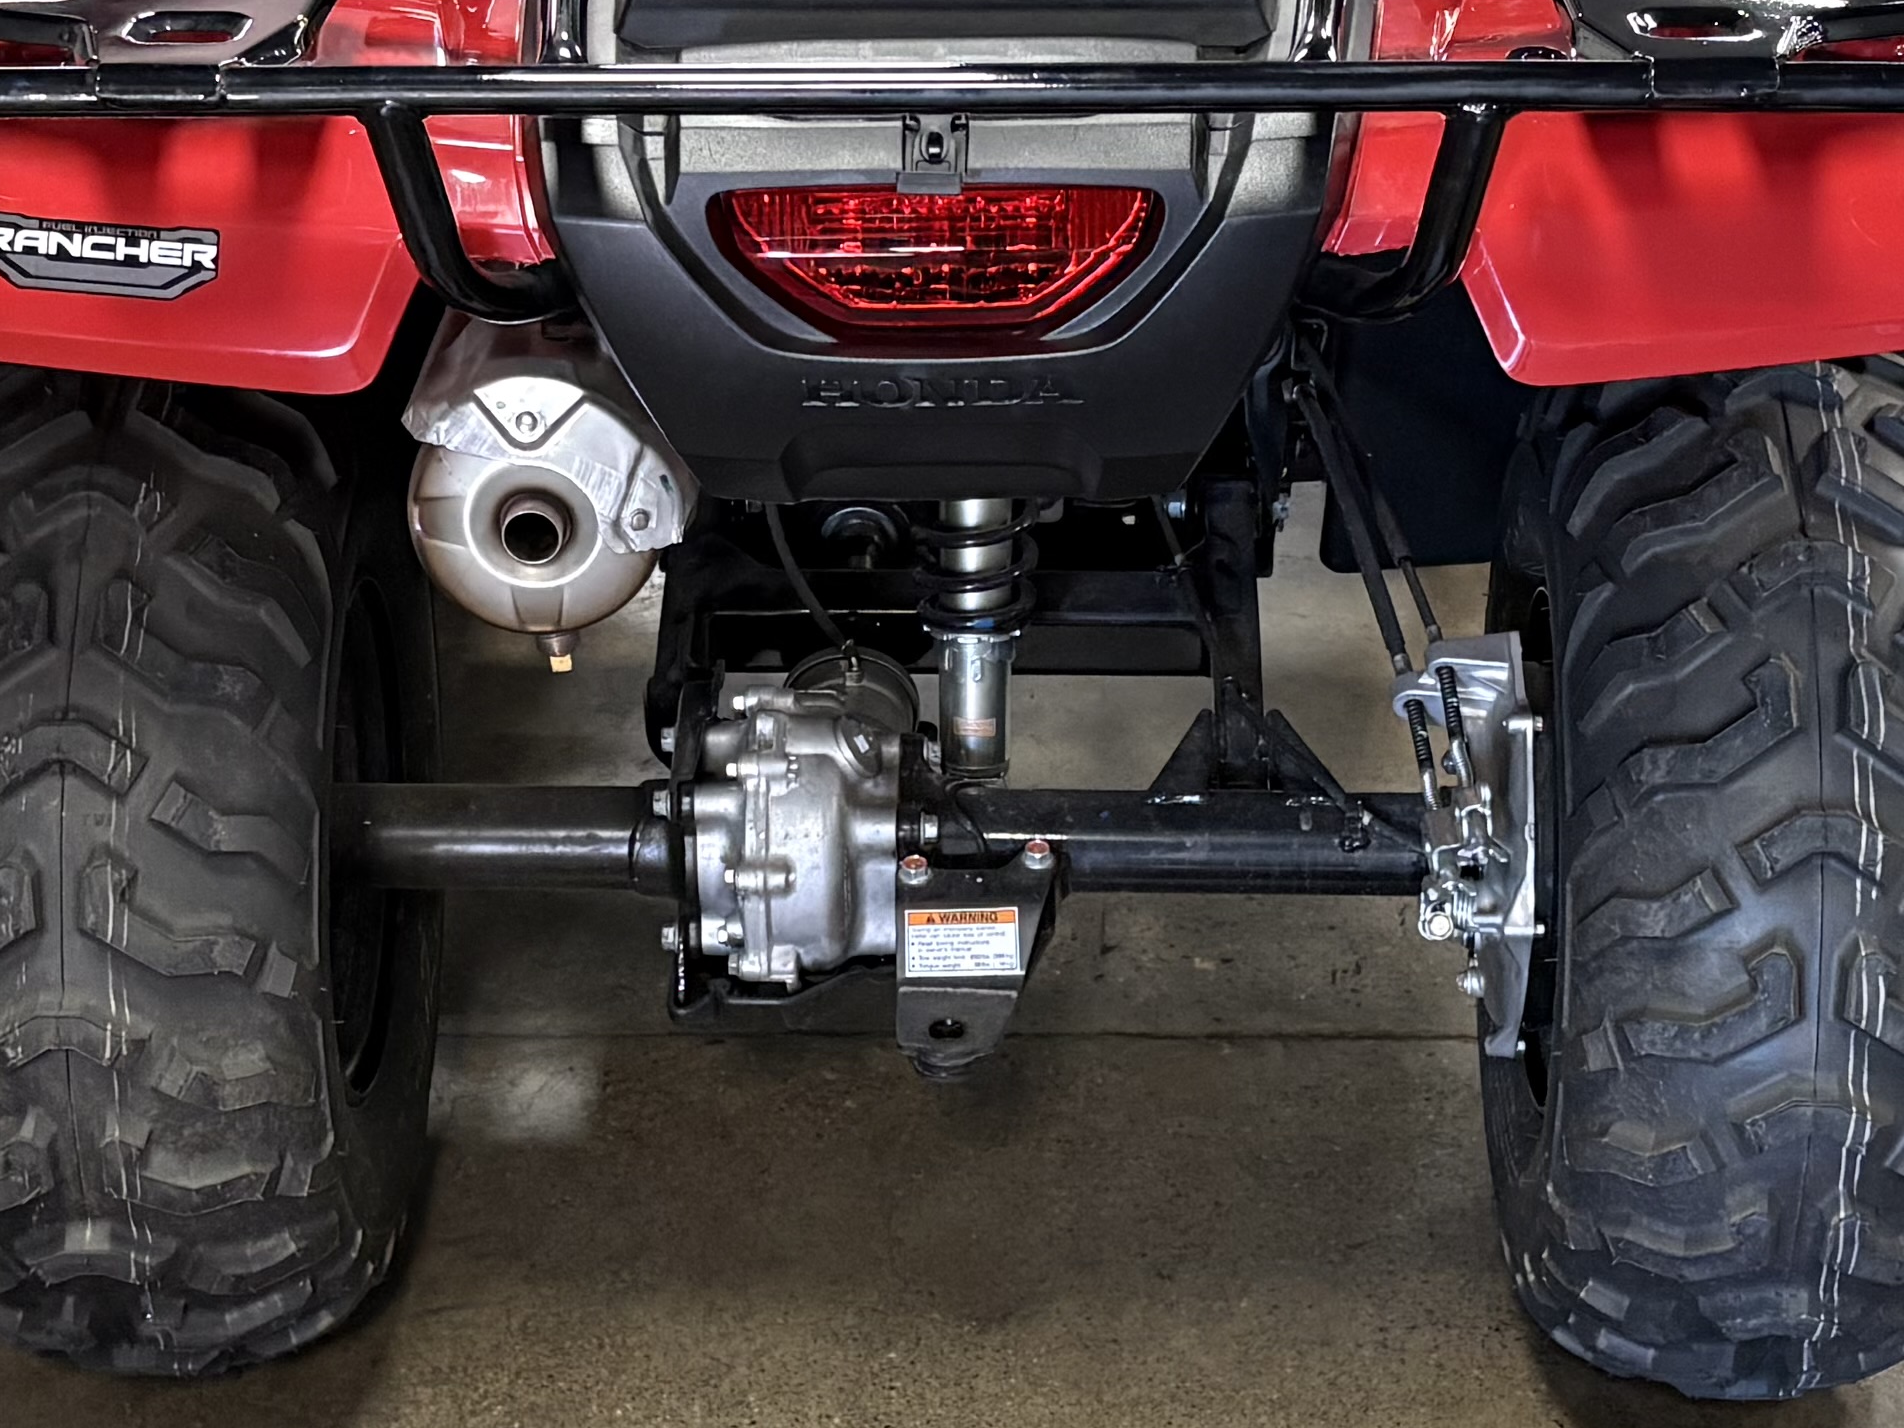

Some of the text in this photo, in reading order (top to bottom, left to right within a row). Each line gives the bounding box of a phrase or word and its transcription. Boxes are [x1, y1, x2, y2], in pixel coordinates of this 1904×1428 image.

[42, 221, 159, 239] FUEL INJECTION
[801, 378, 1085, 408] HONDA
[939, 911, 999, 923] WARNING
